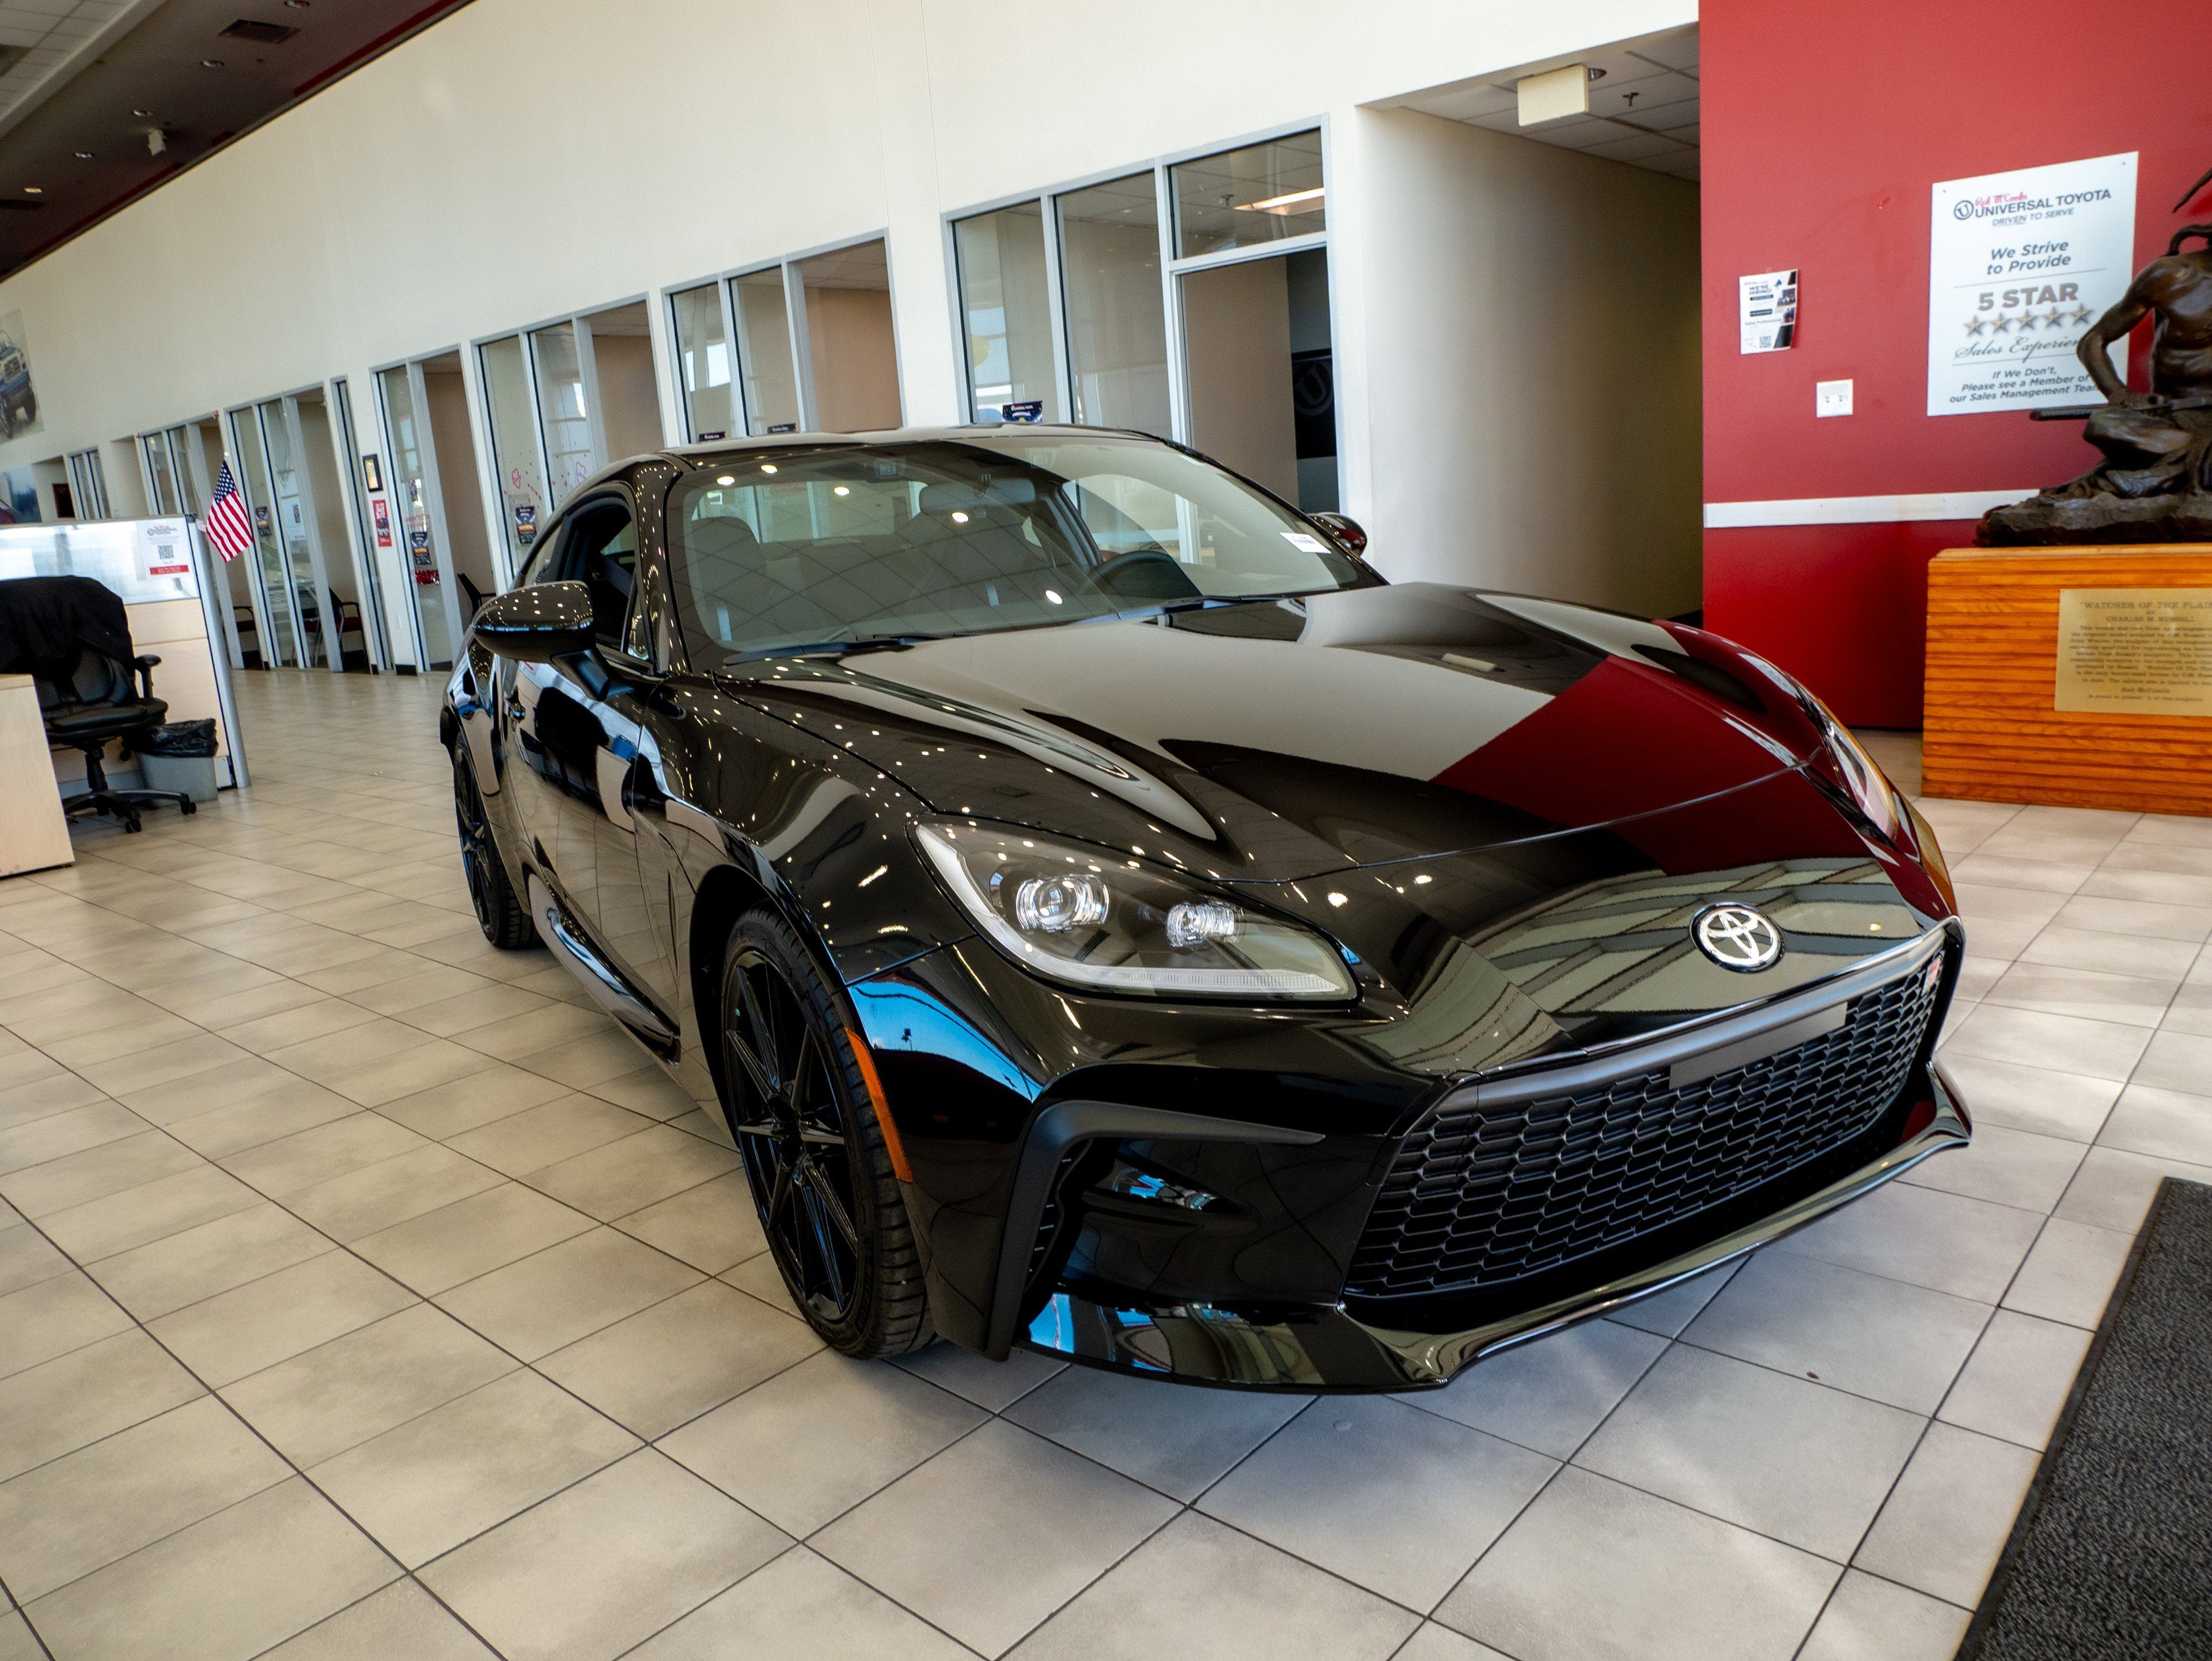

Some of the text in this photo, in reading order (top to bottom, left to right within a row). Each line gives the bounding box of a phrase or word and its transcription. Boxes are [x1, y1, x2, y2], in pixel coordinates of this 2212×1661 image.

[1975, 198, 2053, 218] UNIVERSAL
[2056, 189, 2111, 206] TOYOTA
[1992, 215, 2027, 226] DRIVEN
[2045, 208, 2075, 218] SERVE
[1991, 241, 2069, 260] We Strive
[1987, 255, 2071, 275] to Provide
[1978, 282, 2079, 311] 5 STAR
[1954, 339, 2003, 359] Sales
[1992, 366, 2057, 379] If We Don't,
[1961, 382, 1995, 392] Please
[1998, 381, 2016, 389] see
[2029, 376, 2075, 386] Member
[2077, 374, 2090, 382] of
[1969, 392, 1997, 402] Sales
[2000, 385, 2070, 399] Management
